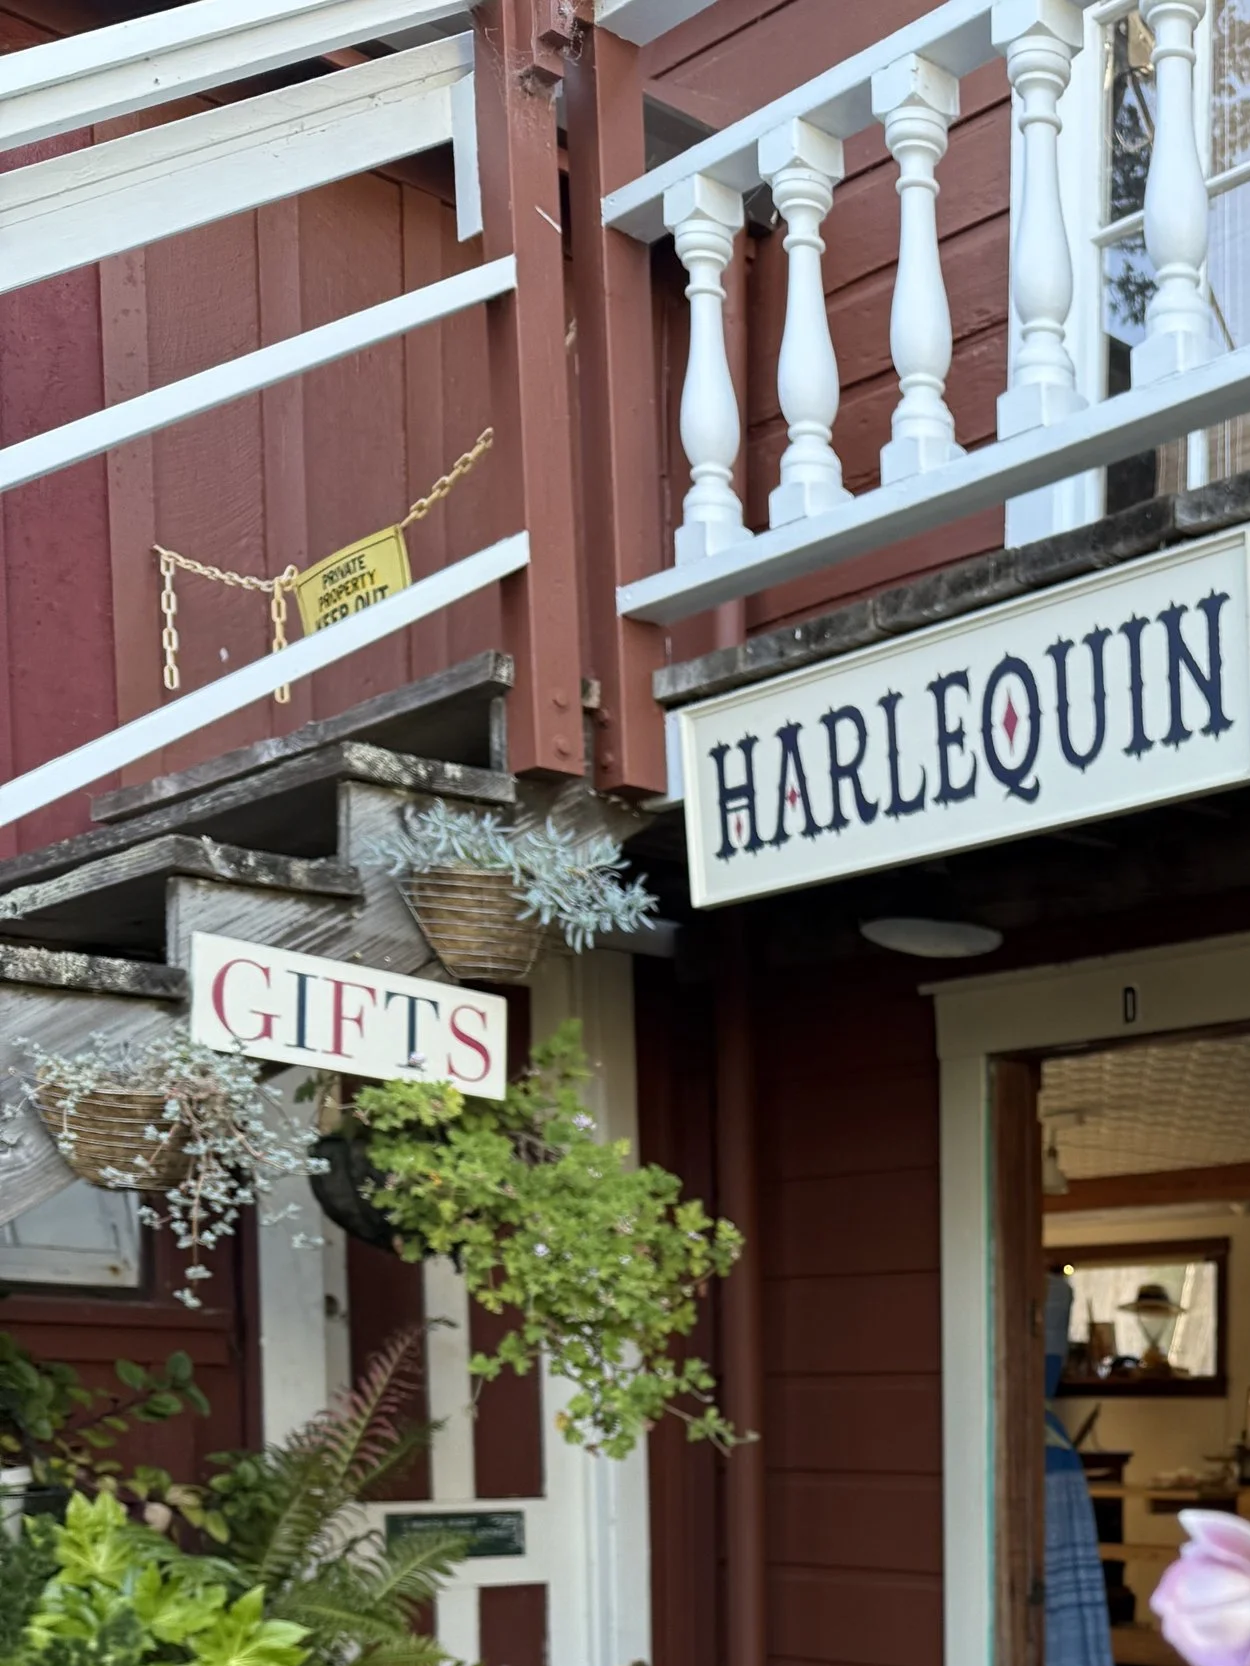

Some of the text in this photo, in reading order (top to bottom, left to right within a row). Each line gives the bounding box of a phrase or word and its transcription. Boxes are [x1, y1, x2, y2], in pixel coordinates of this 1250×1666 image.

[318, 569, 376, 613] PROPERTY
[322, 554, 366, 590] PRIVATE
[708, 588, 1234, 862] HARLEQUIN
[212, 958, 492, 1083] GIFTS
